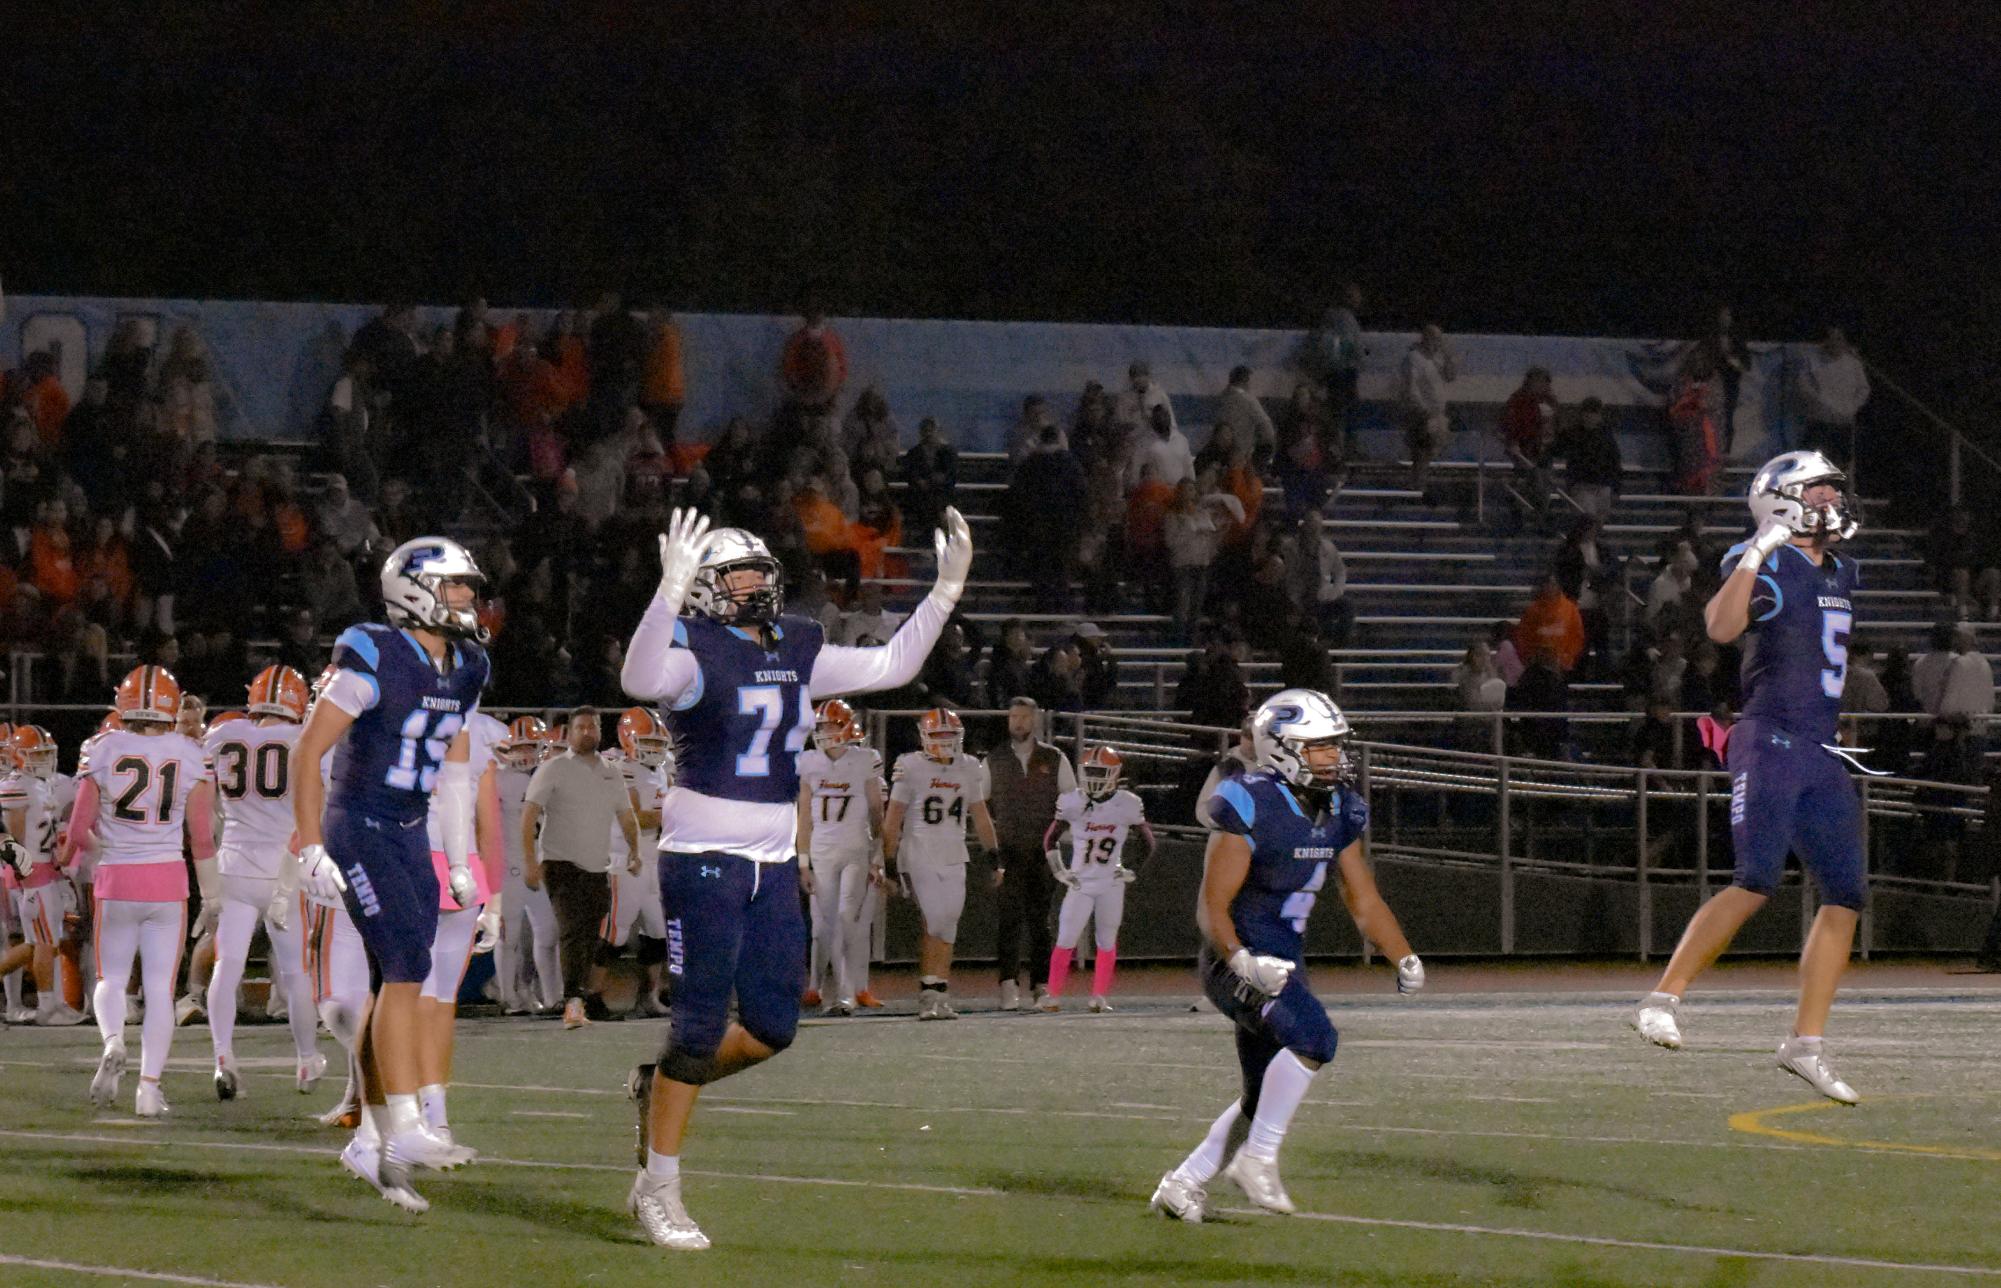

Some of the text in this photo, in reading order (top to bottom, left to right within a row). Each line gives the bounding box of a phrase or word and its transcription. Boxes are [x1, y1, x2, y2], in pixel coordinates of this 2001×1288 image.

[1821, 610, 1852, 698] 5
[754, 669, 798, 683] KNIGHTS
[422, 696, 461, 712] KNIGHTS
[112, 755, 181, 825] 21
[217, 739, 291, 800] 30
[821, 796, 851, 822] 17
[922, 796, 964, 825] 64
[1731, 771, 1748, 825] TEMPO
[1084, 837, 1117, 864] 19
[1294, 847, 1334, 859] KNIGHTS
[347, 862, 381, 917] TEMPO
[667, 918, 684, 975] TEMPO
